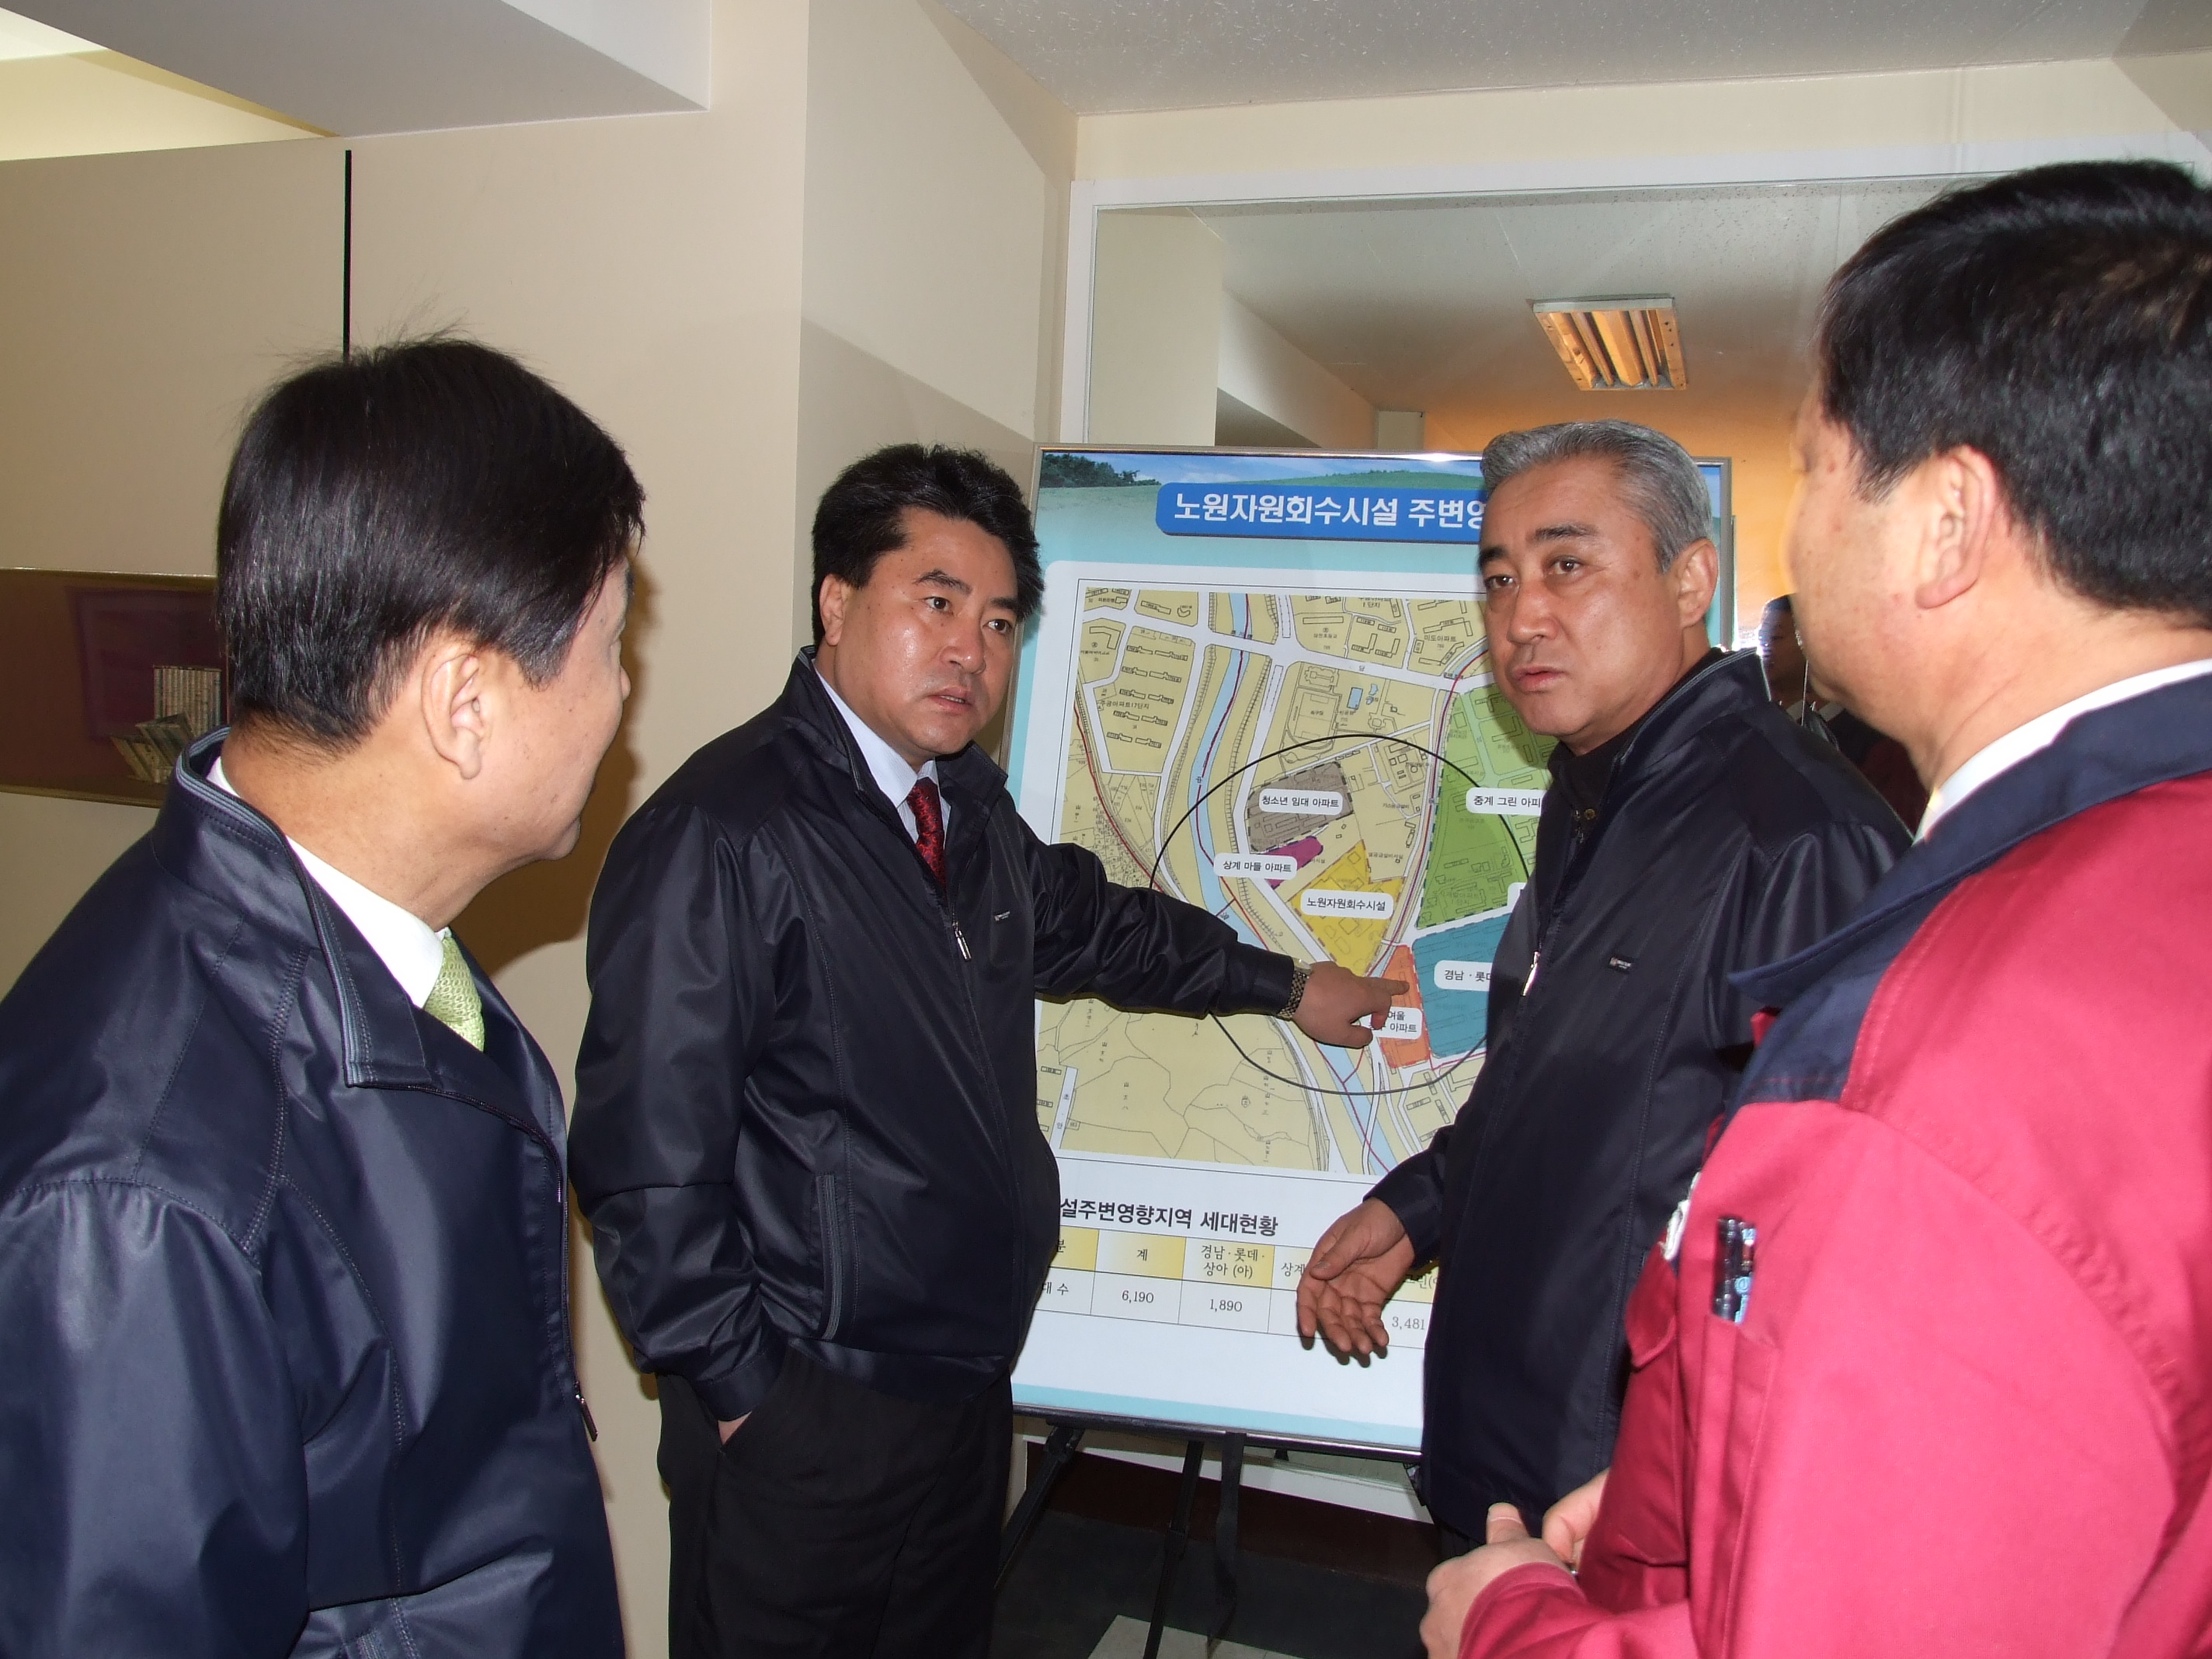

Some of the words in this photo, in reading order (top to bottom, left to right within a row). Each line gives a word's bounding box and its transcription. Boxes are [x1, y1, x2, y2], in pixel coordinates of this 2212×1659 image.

[1174, 492, 1398, 527] 노원자원회수시설
[1262, 795, 1289, 805] 청소년
[1292, 797, 1309, 807] 임대
[1312, 798, 1340, 808] 아파트
[1473, 795, 1494, 806] 중계
[1497, 797, 1517, 807] 그린
[1223, 860, 1241, 871] 상계
[1243, 861, 1262, 871] 마들
[1264, 862, 1292, 872] 아파트
[1306, 896, 1386, 912] 노원자원회수시설
[1389, 1022, 1417, 1033] 아파트
[1061, 1198, 1192, 1228] 설주변영향지역
[1200, 1211, 1278, 1236] 세대현황
[1136, 1248, 1148, 1261] 계
[1204, 1262, 1228, 1276] 상아
[1122, 1290, 1154, 1304] 6,190
[1209, 1299, 1243, 1312] 1,890
[1391, 1316, 1425, 1330] 3,481
